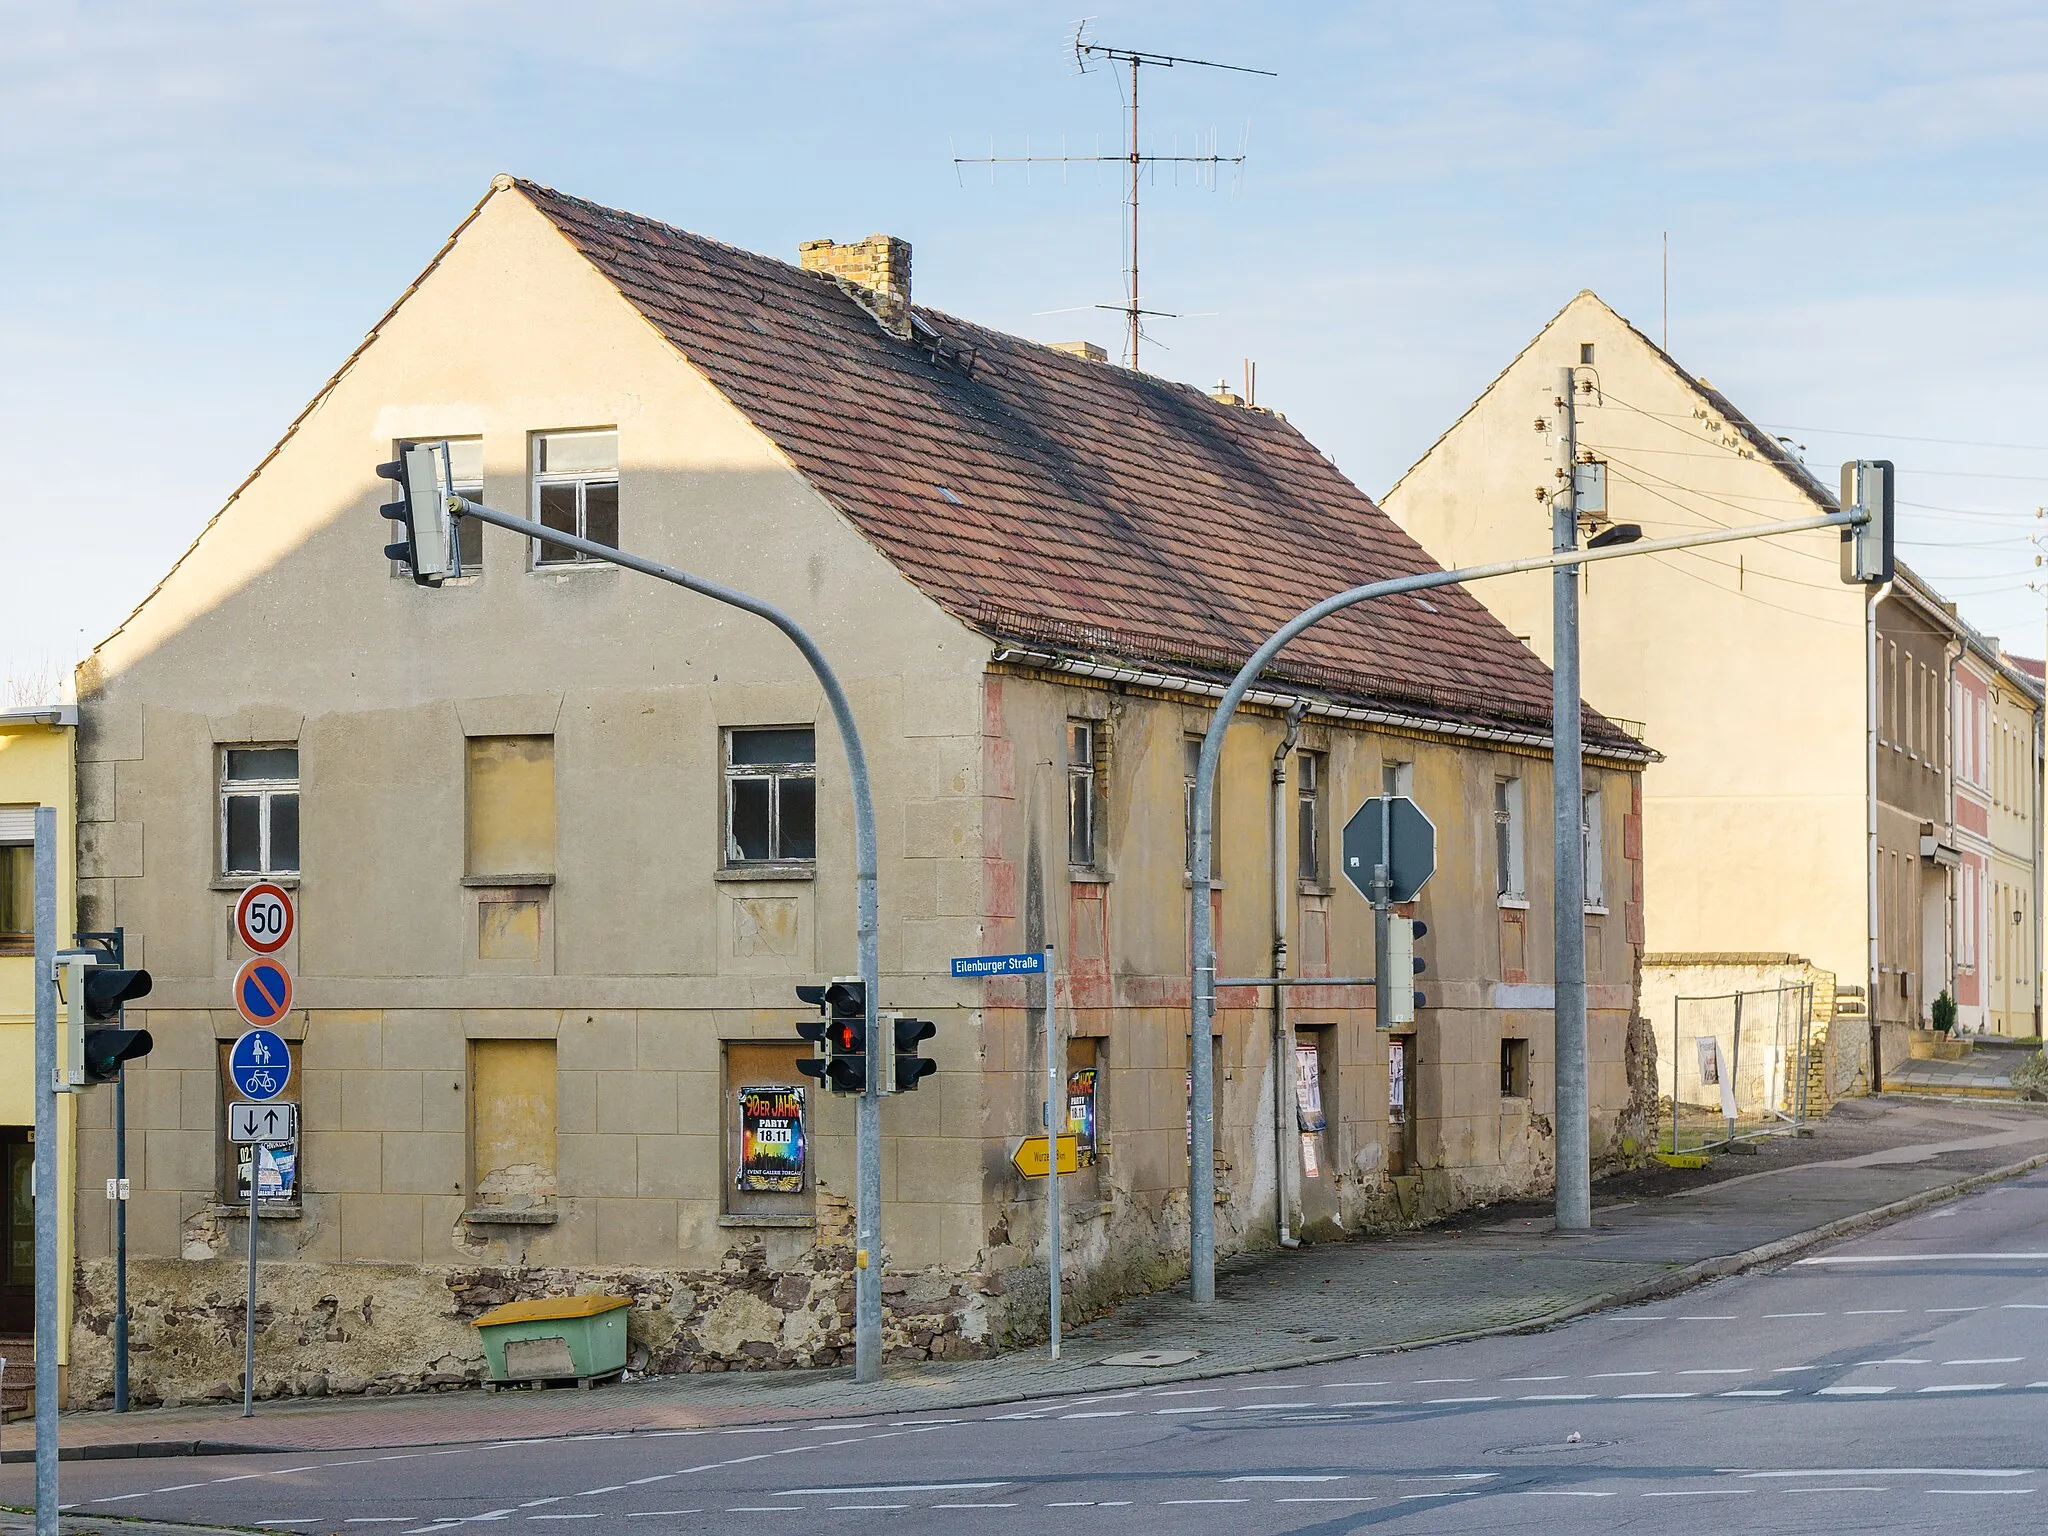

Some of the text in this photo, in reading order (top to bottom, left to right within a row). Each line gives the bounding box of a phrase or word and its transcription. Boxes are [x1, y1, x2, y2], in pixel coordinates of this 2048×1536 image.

[251, 903, 282, 934] 50
[956, 957, 1038, 974] Eilenburger Straße
[745, 1094, 770, 1117] 90ER
[1071, 1096, 1085, 1105] PARTY
[759, 1119, 788, 1128] PARTY
[760, 1130, 790, 1142] 18.11.
[1034, 1151, 1050, 1162] Wurze
